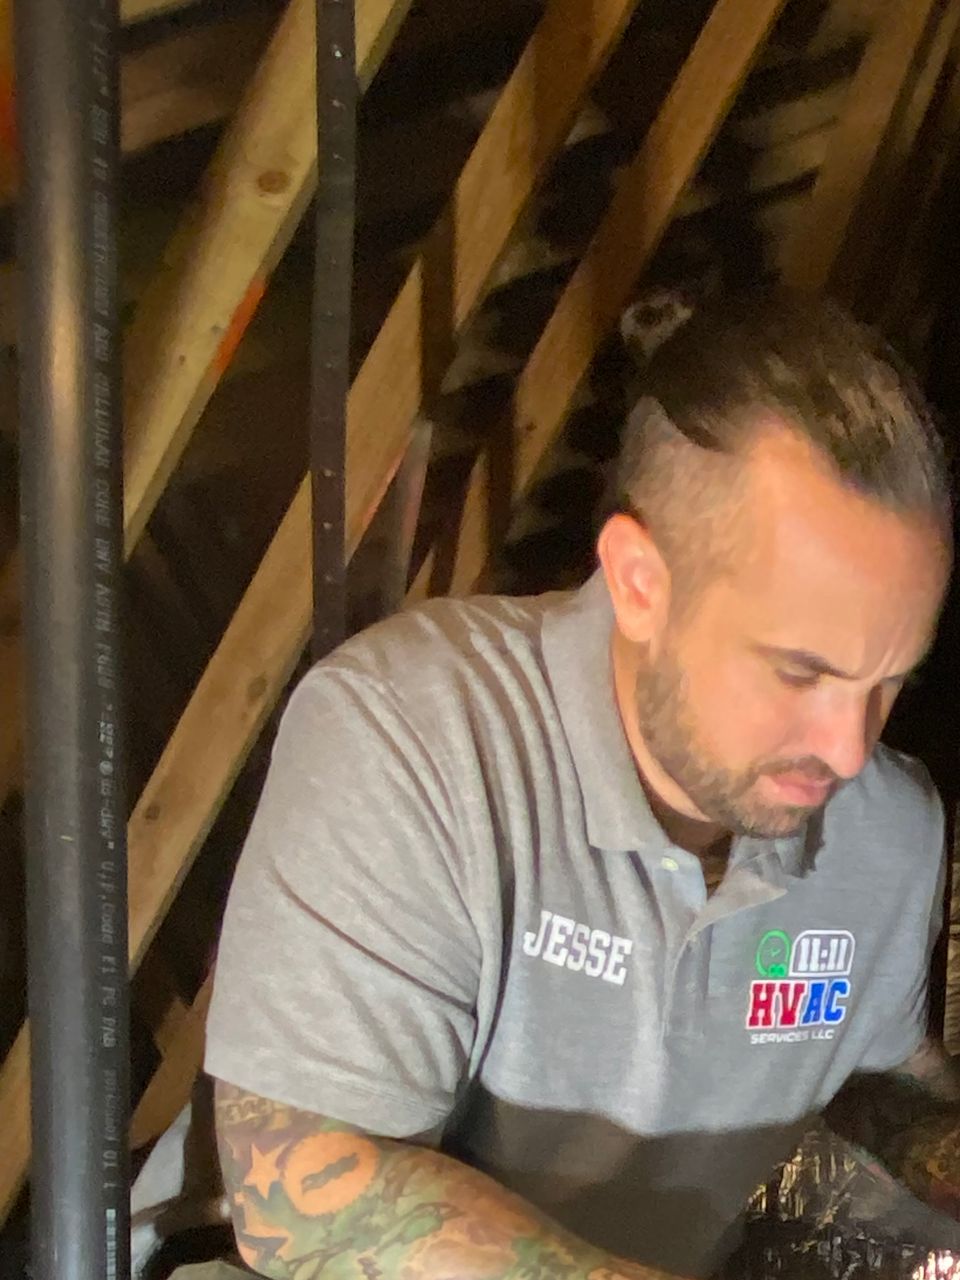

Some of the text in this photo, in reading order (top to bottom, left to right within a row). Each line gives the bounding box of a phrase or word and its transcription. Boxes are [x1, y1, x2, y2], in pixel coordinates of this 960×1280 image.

[523, 910, 633, 986] JESSE
[797, 937, 849, 971] 11:11
[746, 979, 851, 1030] HVAC
[750, 1029, 835, 1045] SERVICES LLC
